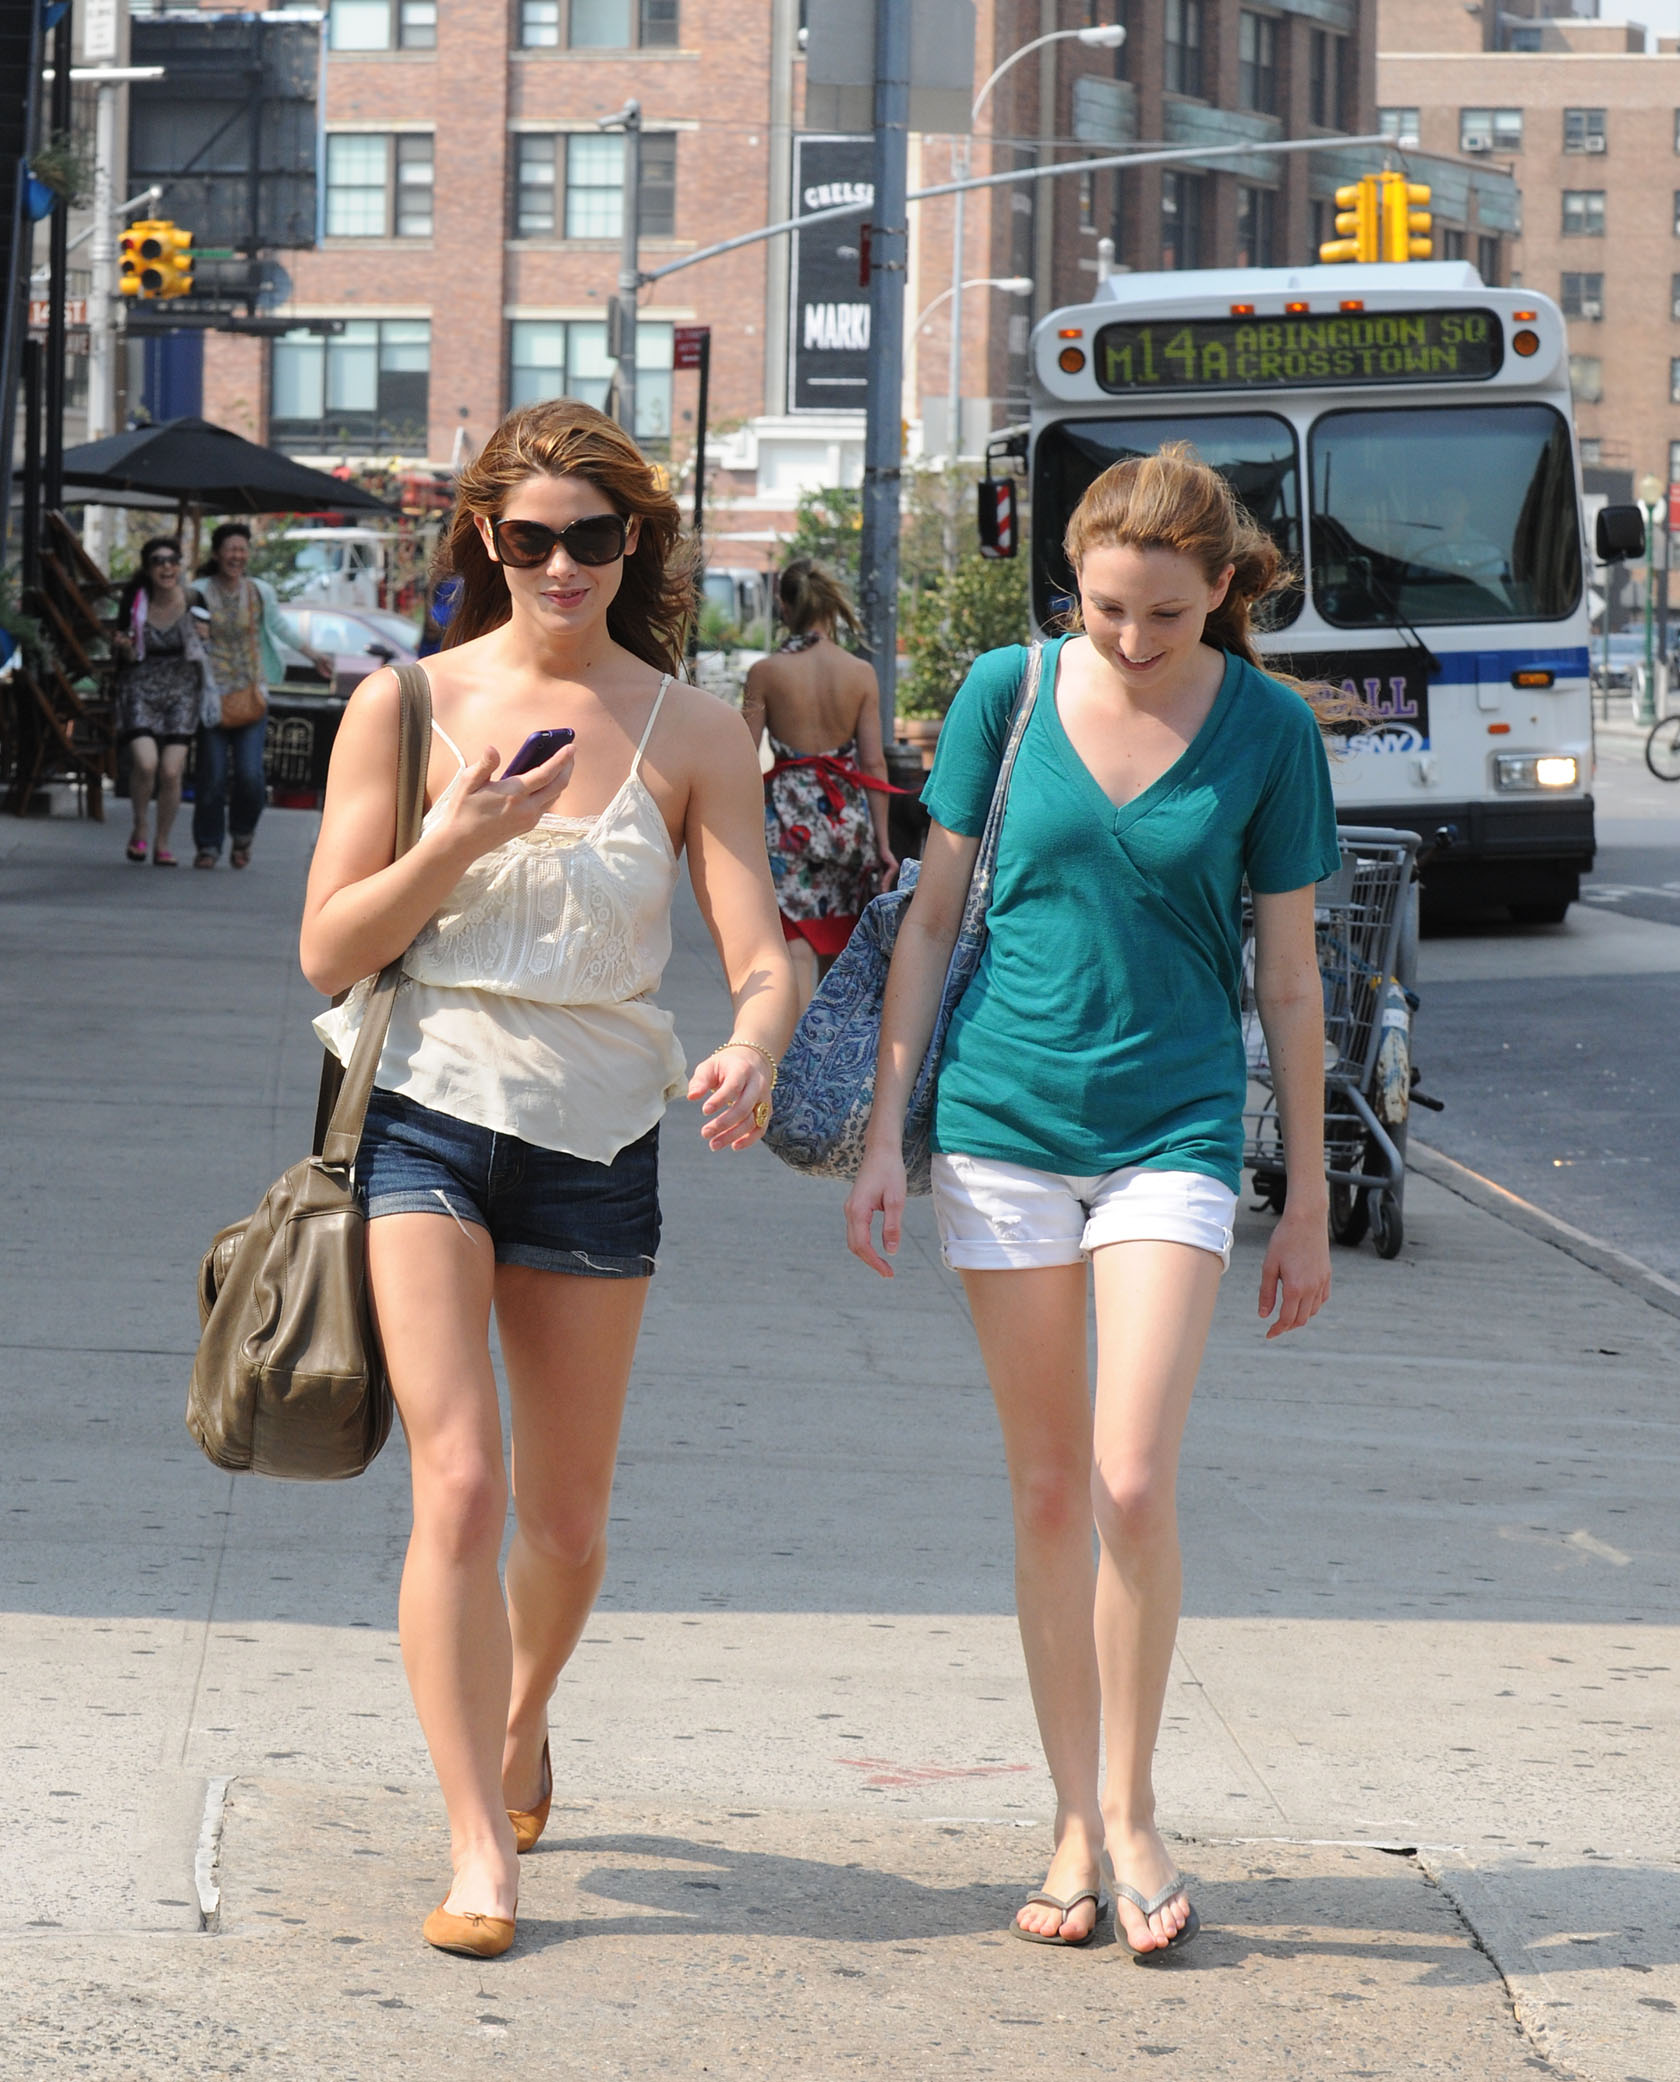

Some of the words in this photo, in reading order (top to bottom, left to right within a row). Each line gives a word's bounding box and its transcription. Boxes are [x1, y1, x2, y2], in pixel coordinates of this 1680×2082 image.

[1106, 327, 1228, 383] M14A
[1235, 317, 1426, 352] ABINGDON
[1441, 315, 1488, 344] SQ
[1236, 345, 1459, 379] CROSSTOWN
[1347, 732, 1411, 754] SNY
